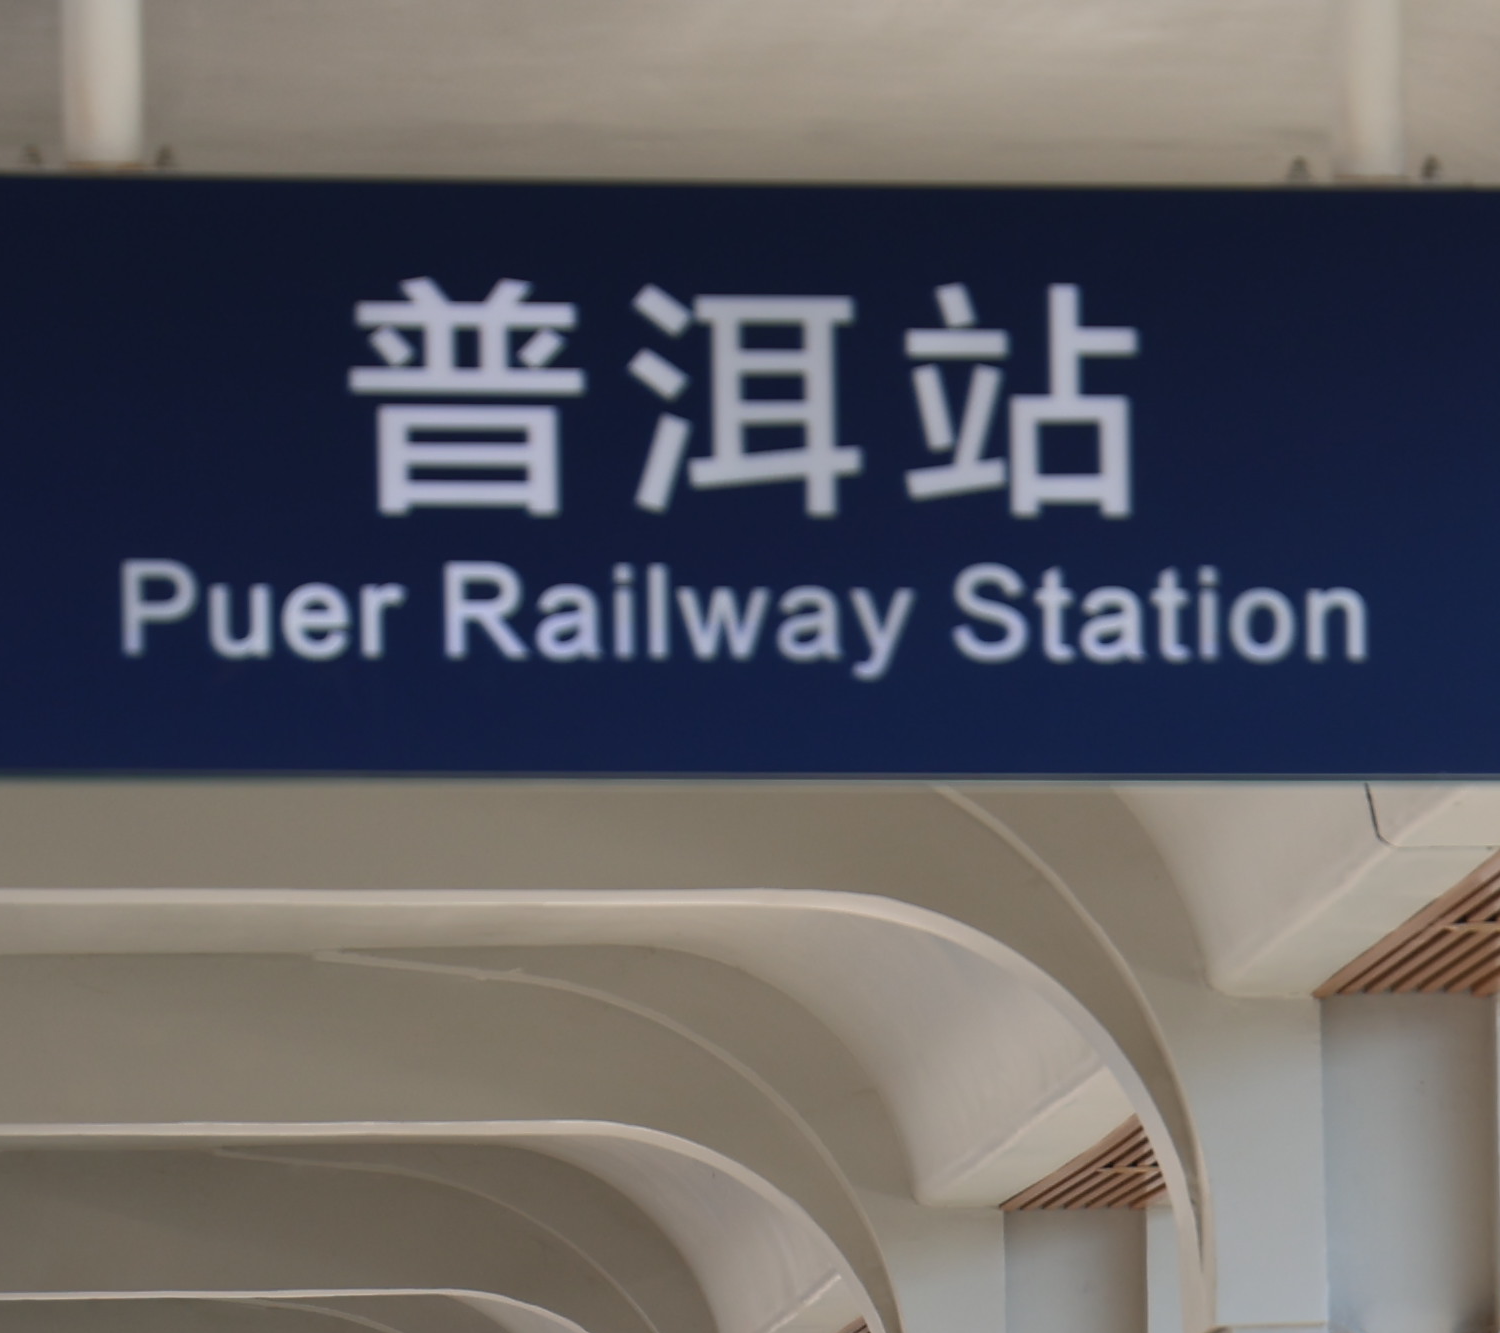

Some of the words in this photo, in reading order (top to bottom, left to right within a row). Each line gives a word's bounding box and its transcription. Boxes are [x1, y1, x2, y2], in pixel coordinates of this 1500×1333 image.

[349, 278, 1137, 517] 普洱站
[121, 560, 403, 659] Puer
[445, 561, 912, 679] Railway
[953, 564, 1367, 662] Station
